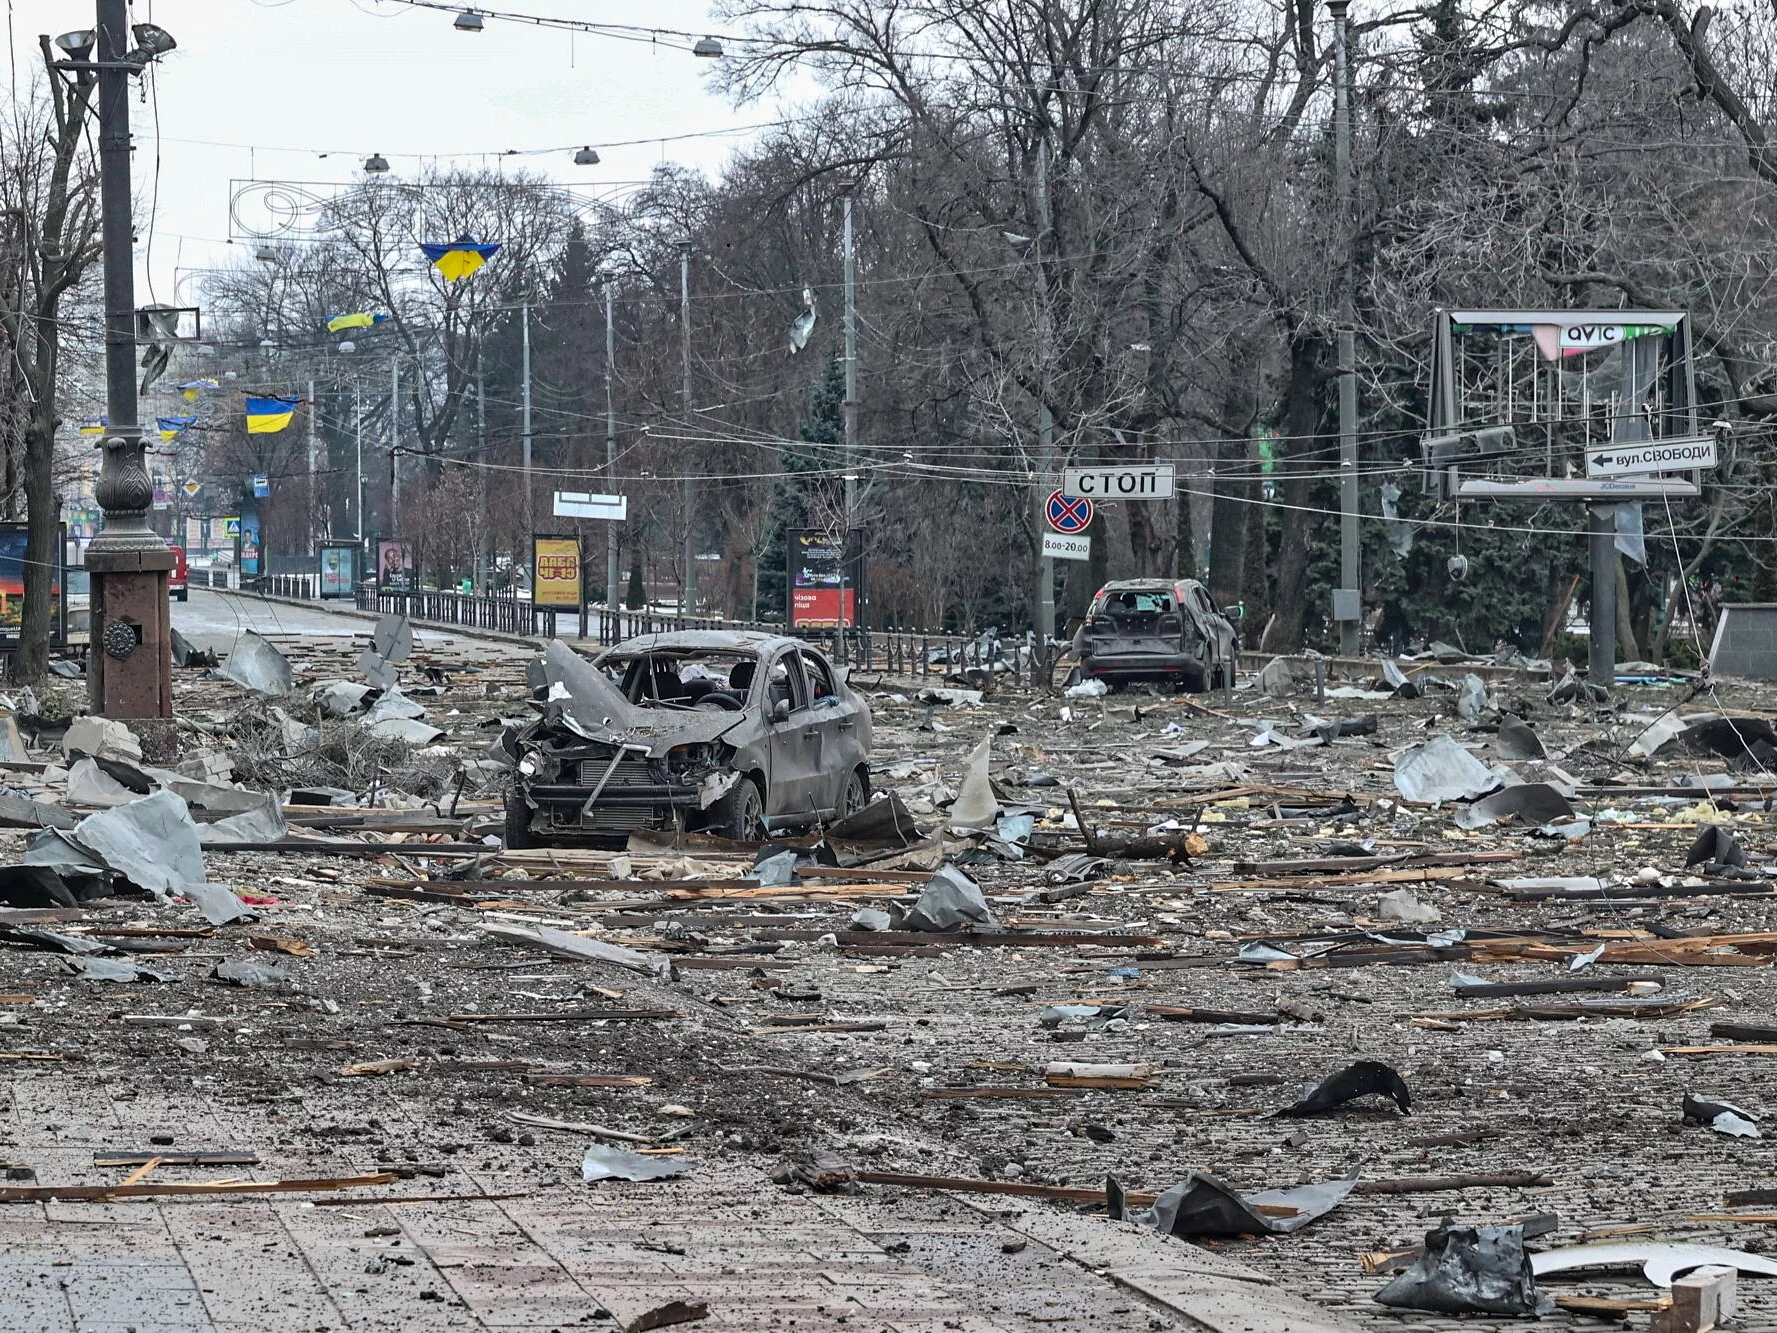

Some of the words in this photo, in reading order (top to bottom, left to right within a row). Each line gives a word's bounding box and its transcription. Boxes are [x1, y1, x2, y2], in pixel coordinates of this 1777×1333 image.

[1616, 445, 1711, 468] вул.СВОБОДИ
[1077, 470, 1156, 494] СТОП
[1043, 539, 1089, 553] 8.00-20.00
